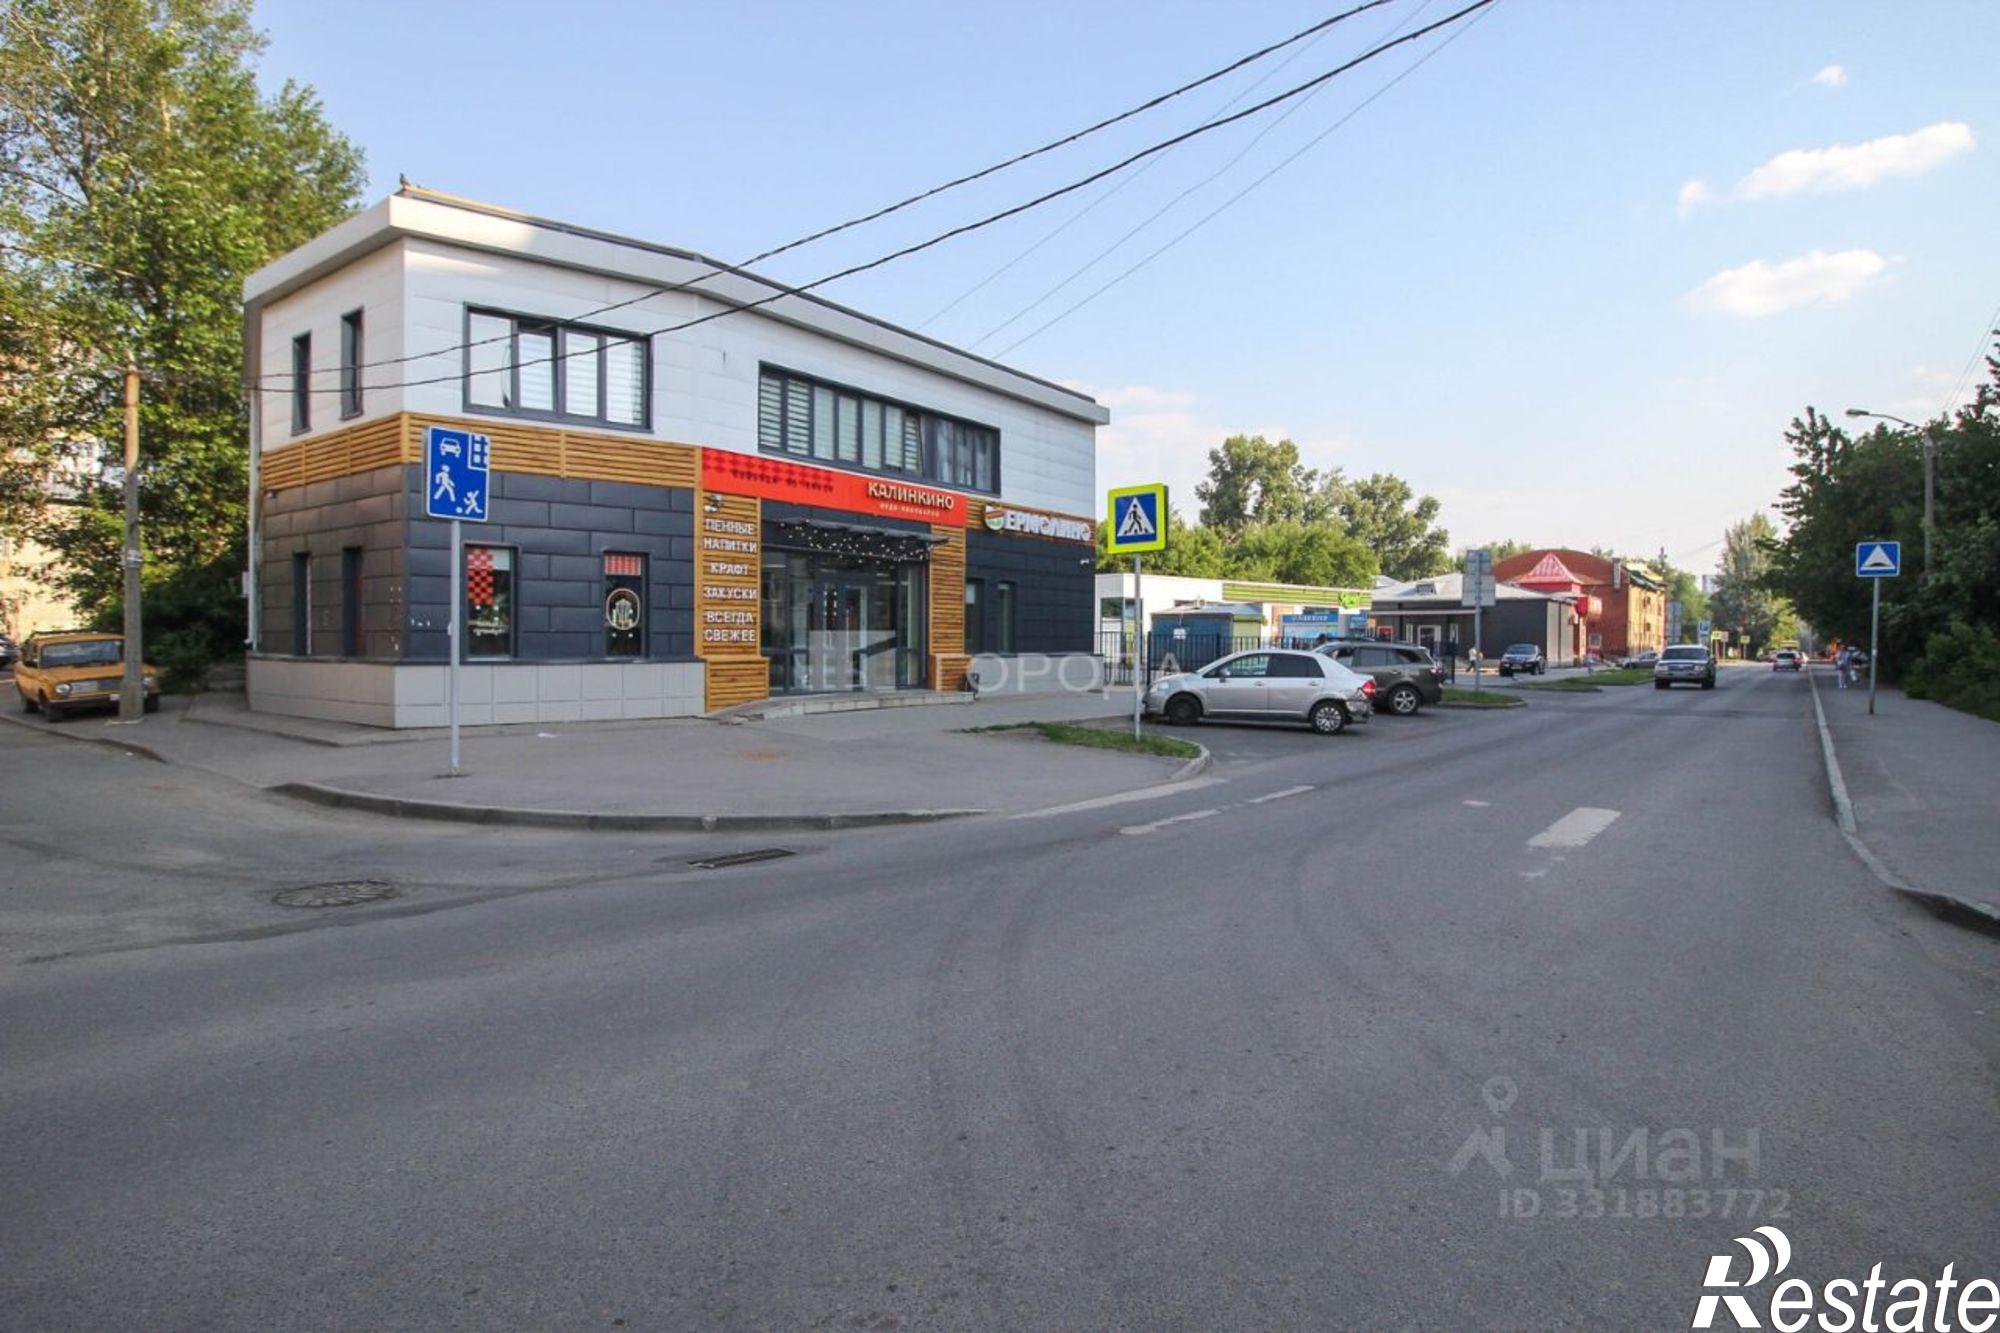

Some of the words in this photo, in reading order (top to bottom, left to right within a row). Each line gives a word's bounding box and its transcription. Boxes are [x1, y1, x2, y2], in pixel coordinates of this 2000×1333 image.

[868, 482, 955, 510] КАЛИНКИНО
[705, 518, 755, 535] ПЕННЫЕ
[704, 537, 758, 553] НАПИТКИ
[711, 562, 749, 575] КРАФТ
[703, 586, 757, 600] ЗАКУСКИ
[707, 610, 754, 625] ВСЕГДА
[705, 629, 756, 642] СВЕЖЕЕ
